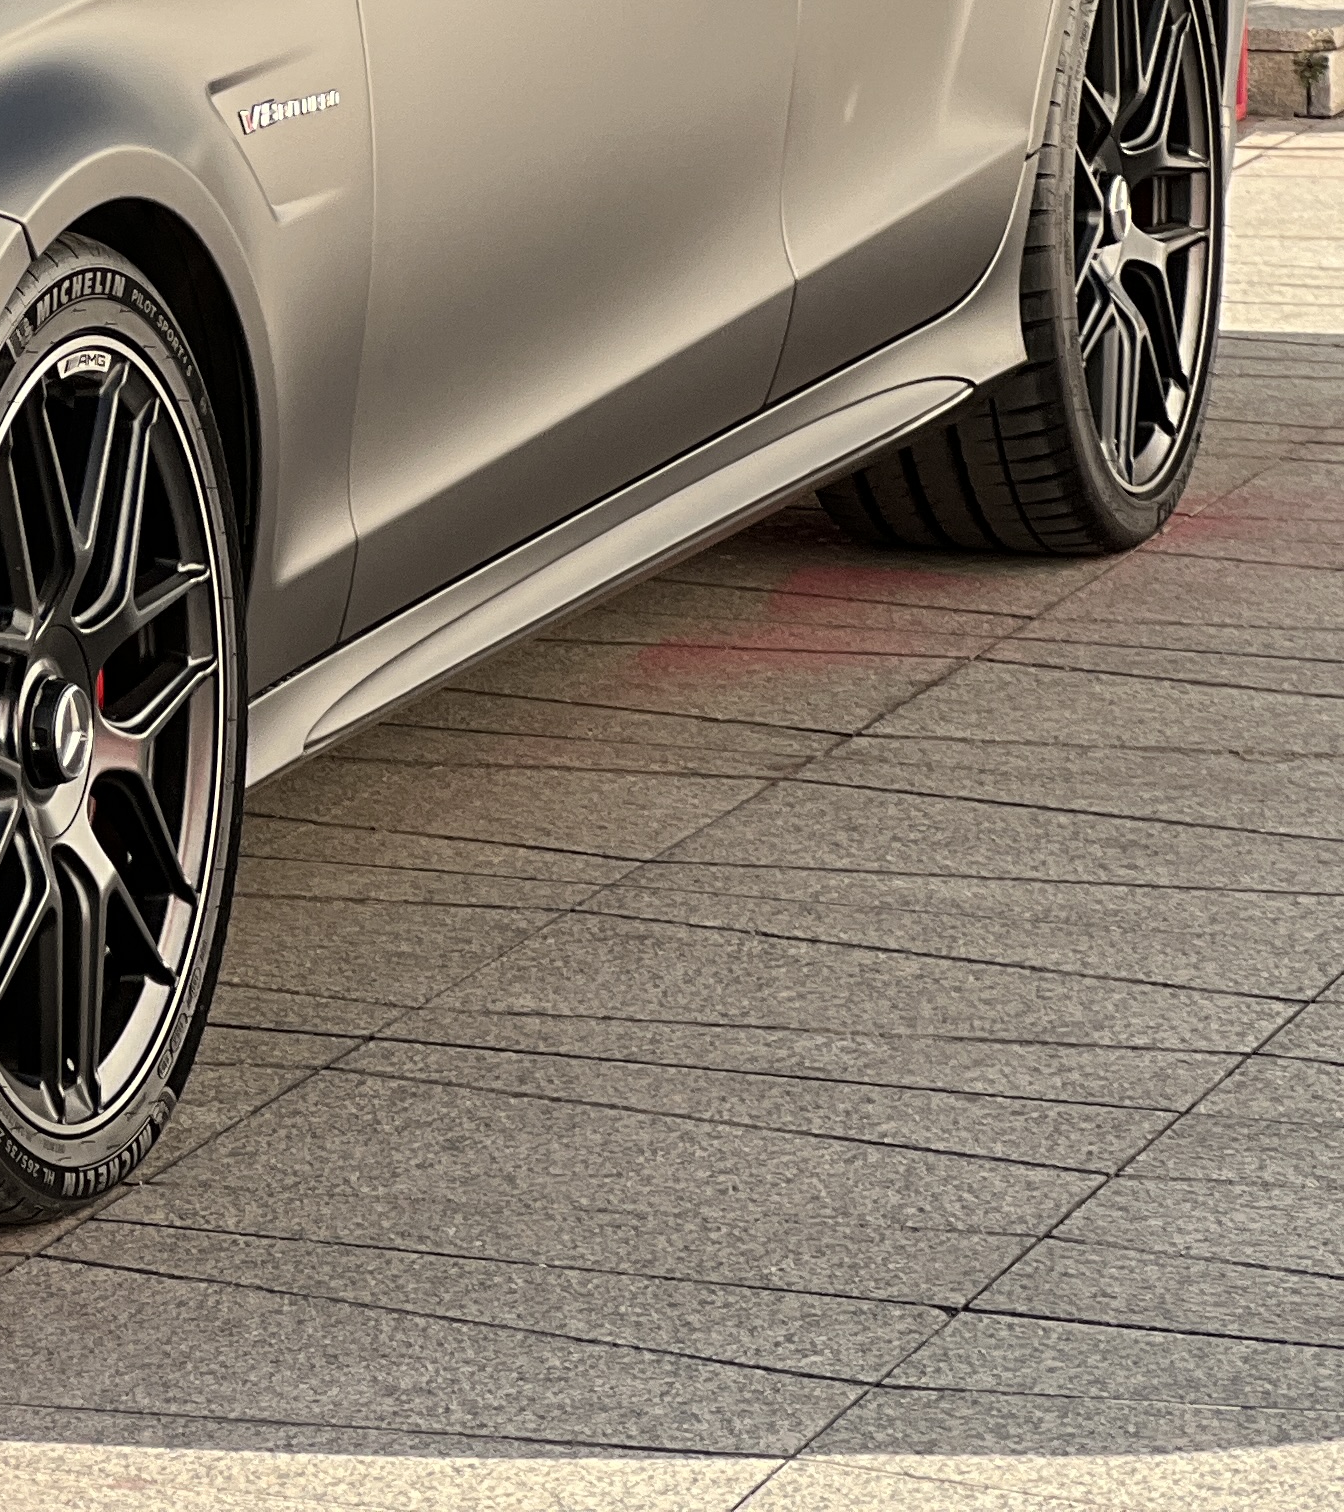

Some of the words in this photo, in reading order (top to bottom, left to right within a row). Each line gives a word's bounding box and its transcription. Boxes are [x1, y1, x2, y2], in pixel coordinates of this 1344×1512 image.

[36, 271, 126, 328] MICHELIN
[130, 289, 158, 319] PILOT
[63, 1123, 153, 1197] MICHELIN
